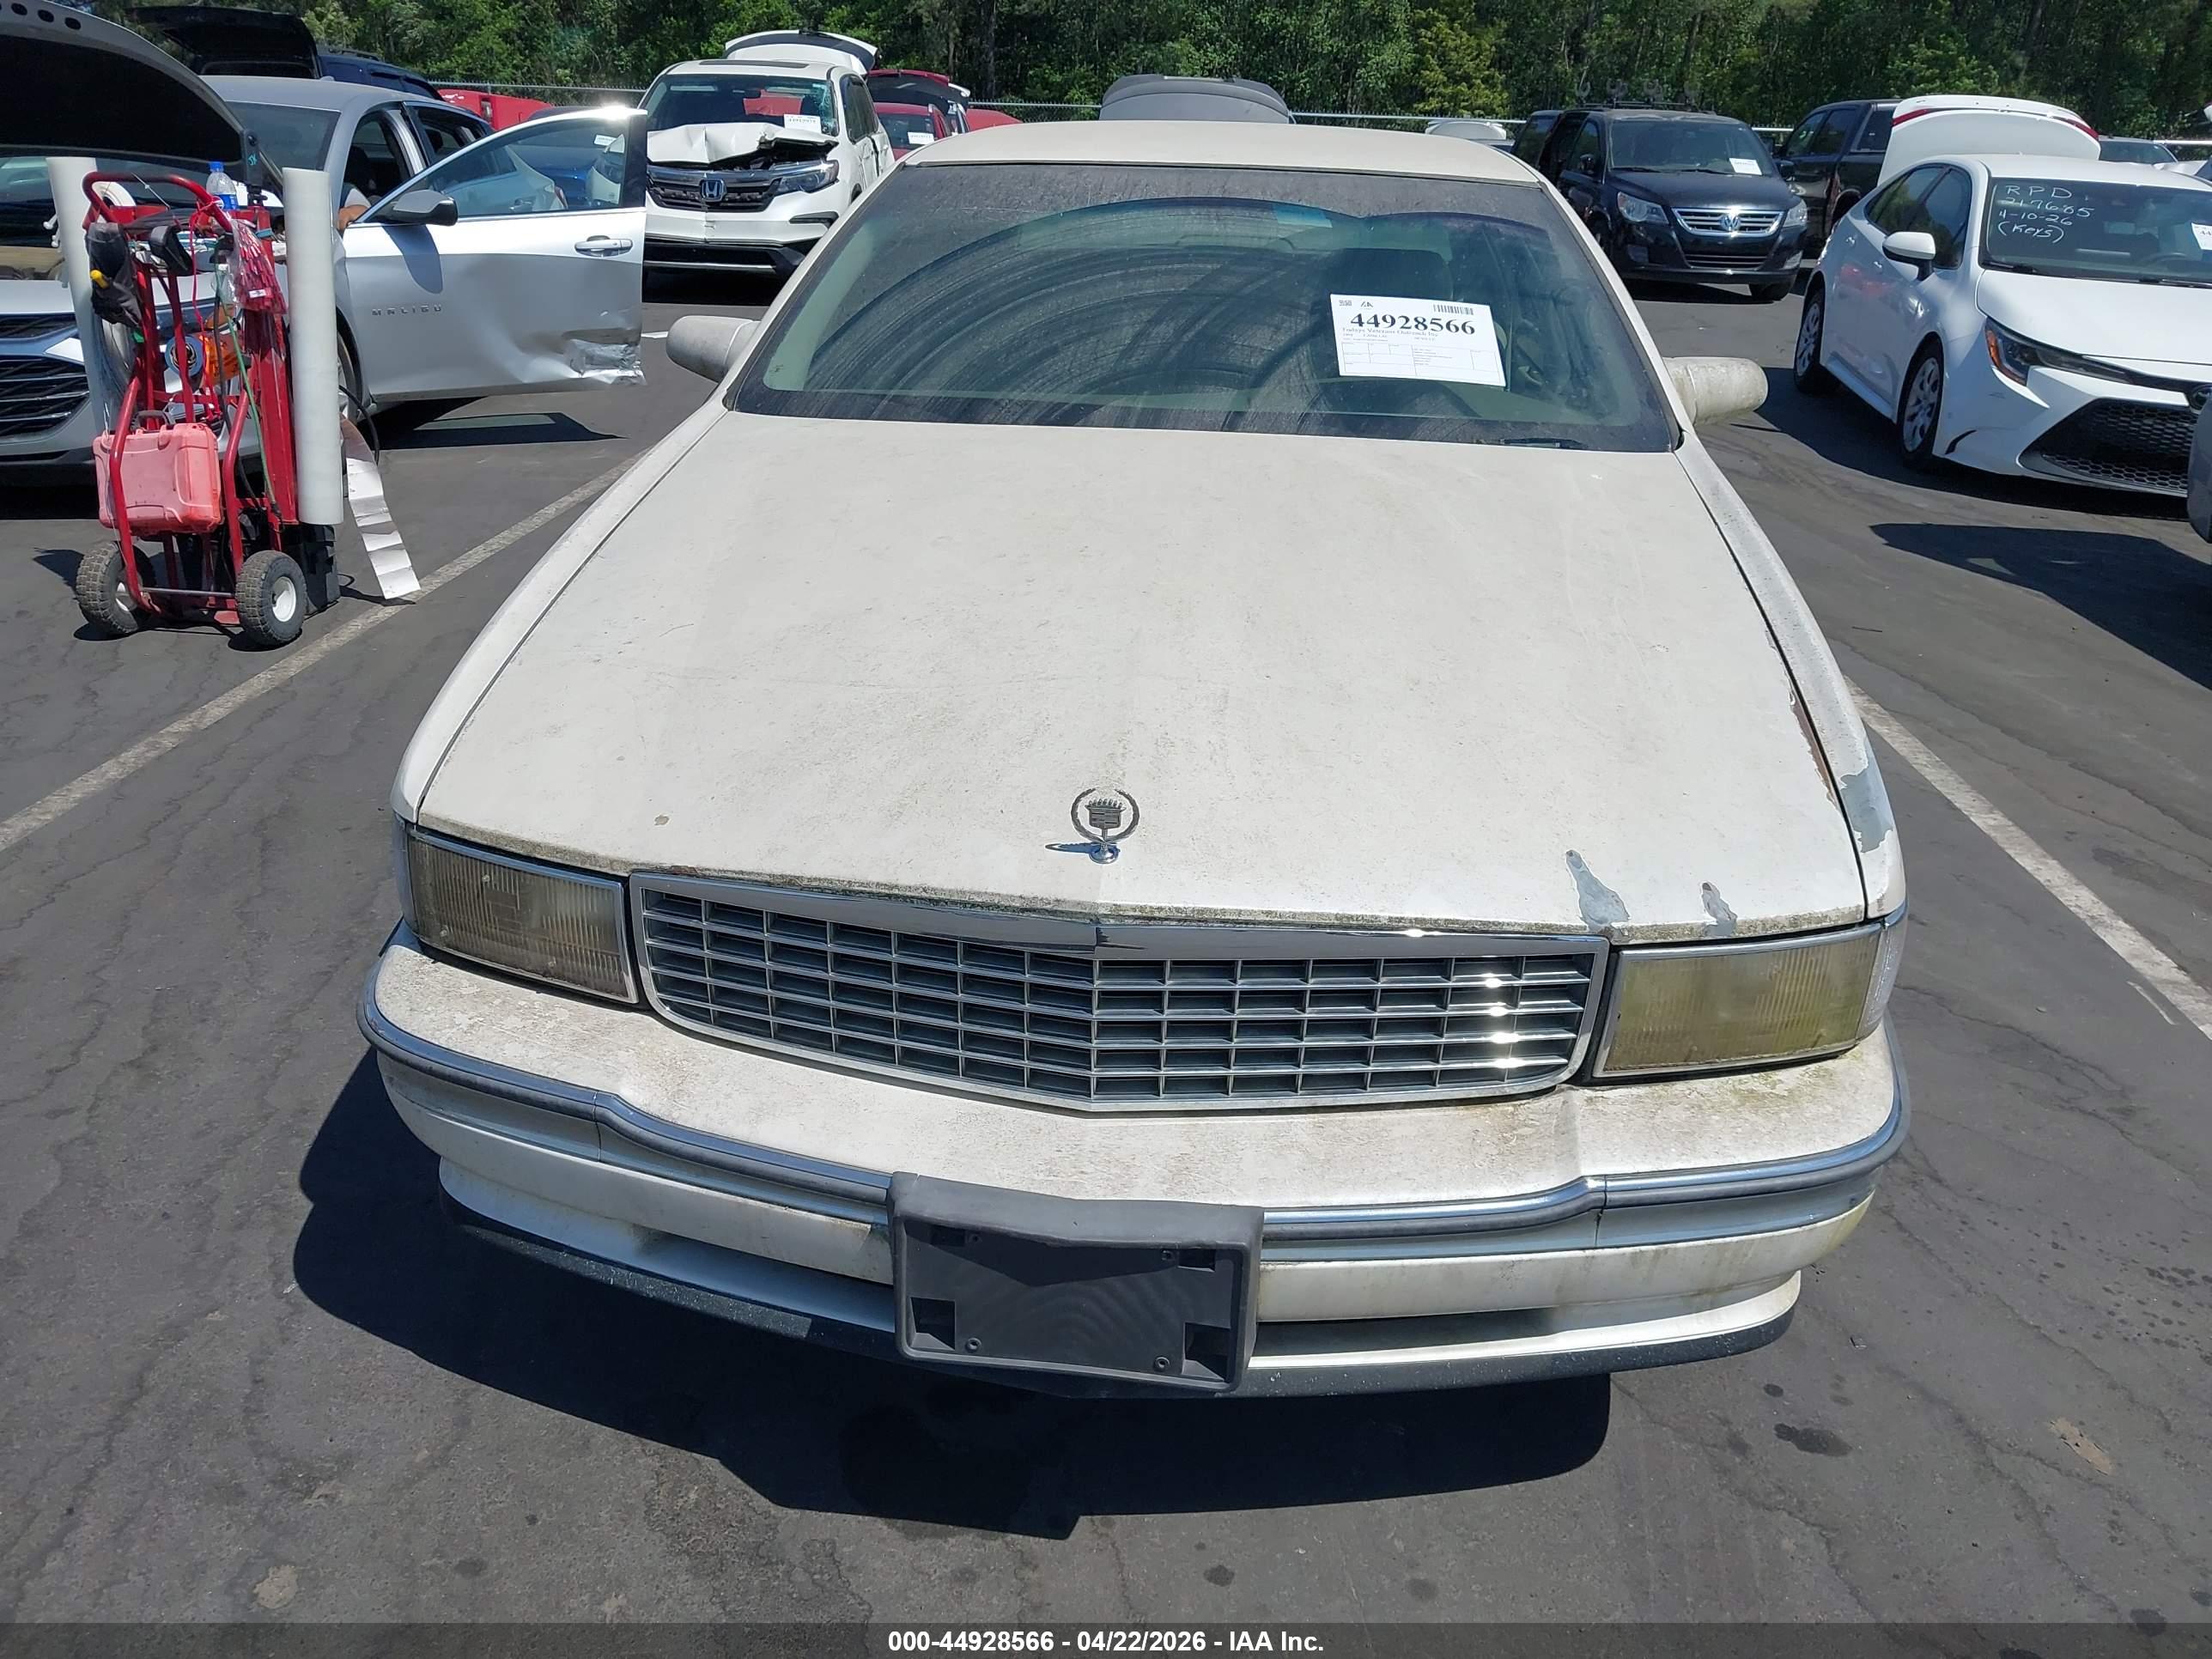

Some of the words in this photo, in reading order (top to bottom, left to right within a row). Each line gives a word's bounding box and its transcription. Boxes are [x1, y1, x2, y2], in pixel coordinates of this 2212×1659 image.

[1999, 209, 2073, 226] 4-10-26
[371, 304, 442, 316] MALIBU
[1350, 313, 1476, 335] 44928566
